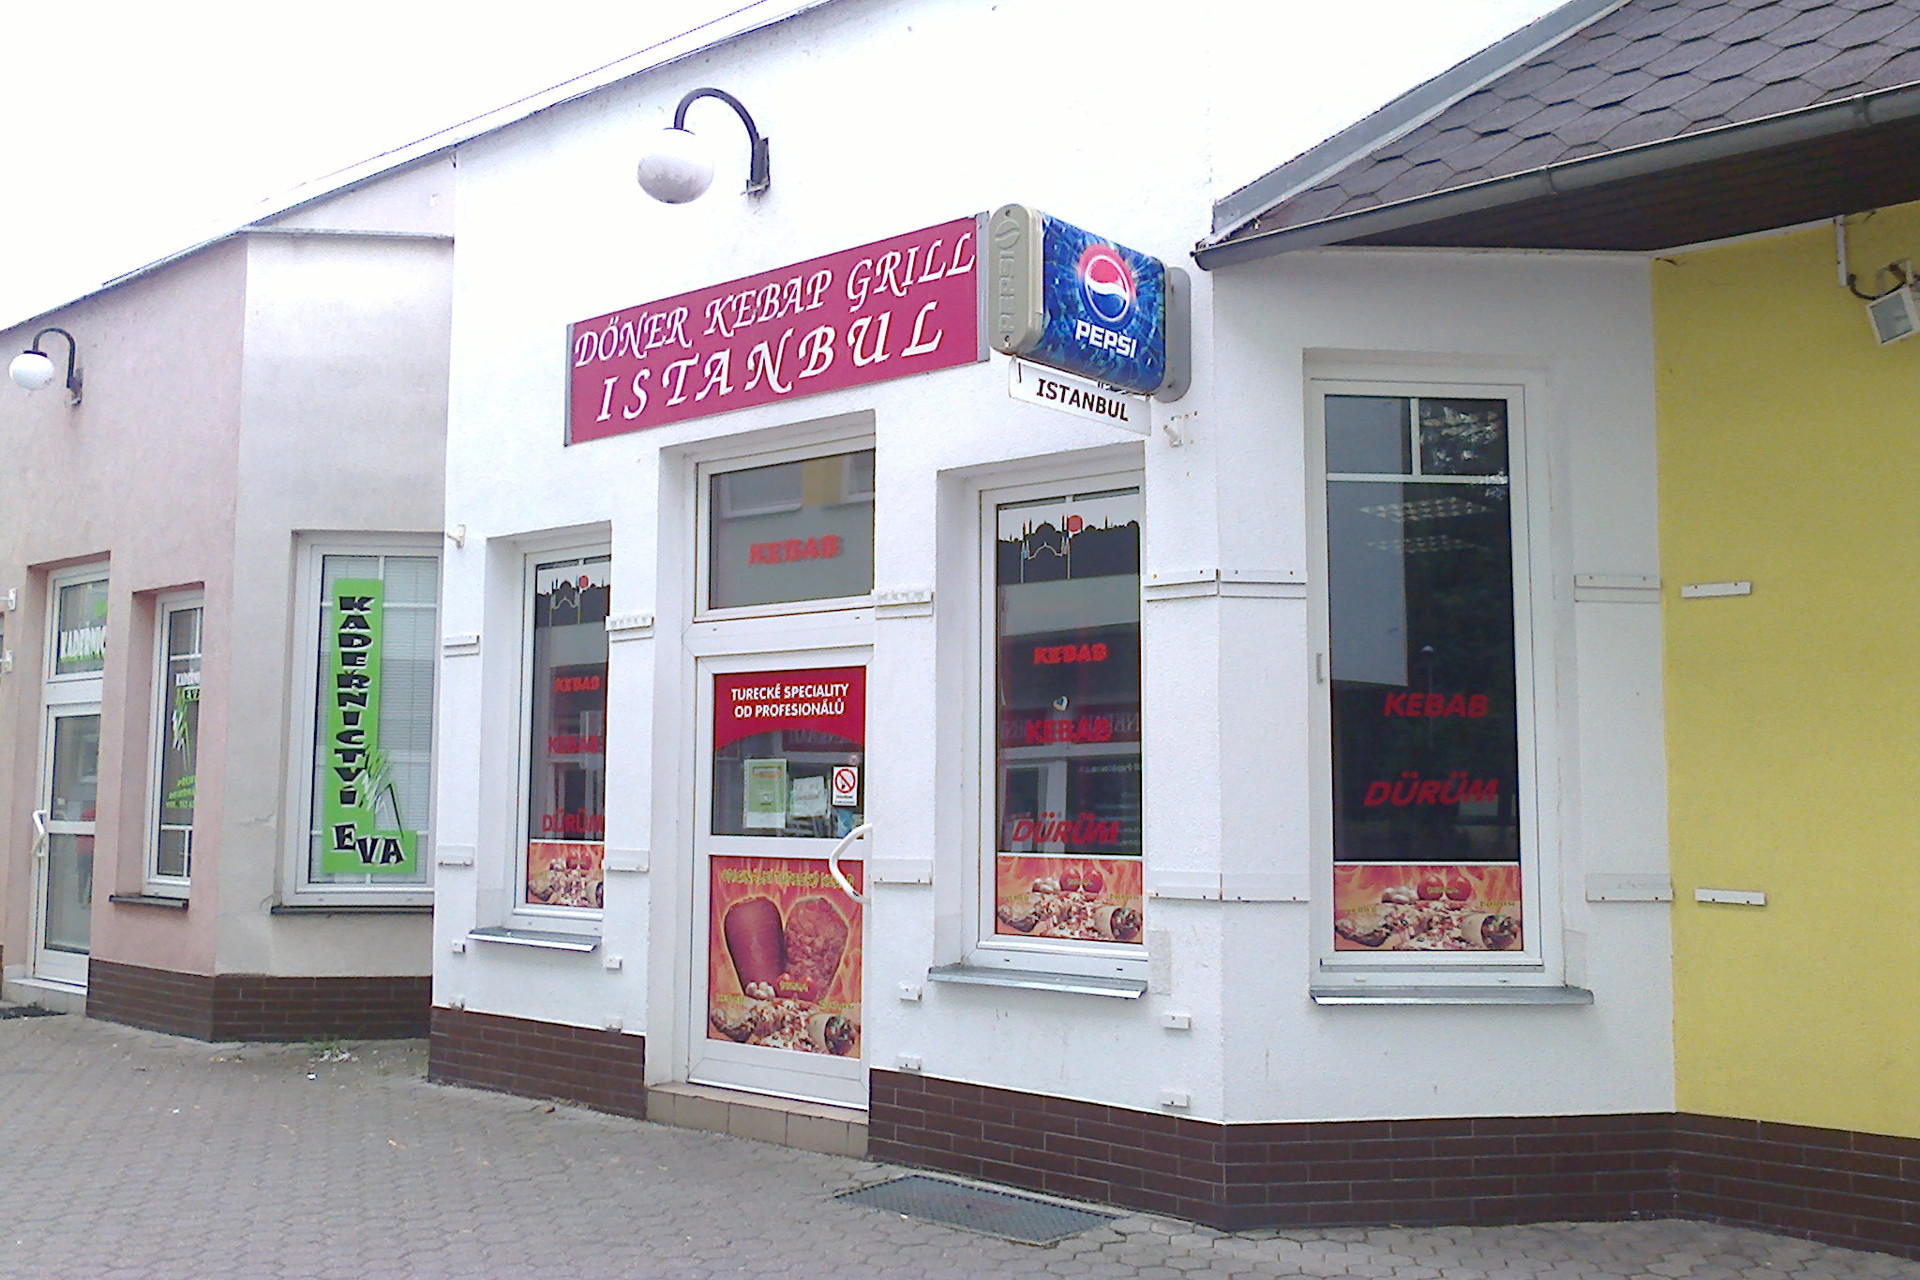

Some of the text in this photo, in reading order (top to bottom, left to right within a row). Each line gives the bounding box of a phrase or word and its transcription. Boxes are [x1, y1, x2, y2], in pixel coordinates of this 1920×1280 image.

[574, 231, 978, 369] DÖNER KEBAP GRILL
[1075, 319, 1137, 358] PEPSI
[596, 300, 943, 423] ISTANBUL
[1036, 377, 1130, 422] ISTANBUL
[748, 533, 841, 567] KEBAB
[1033, 643, 1108, 665] KEBAB
[333, 594, 375, 806] KADEŘNICTVÍ
[730, 683, 849, 701] TURECKÉ SPECIALITY
[734, 698, 845, 718] OD PROFESIONÁLŮ
[1383, 692, 1489, 718] KEBAB
[1025, 717, 1113, 743] KEBAB
[1363, 770, 1499, 807] DÜRÜM
[331, 823, 405, 866] EVA
[1012, 811, 1120, 844] DÜRÜM
